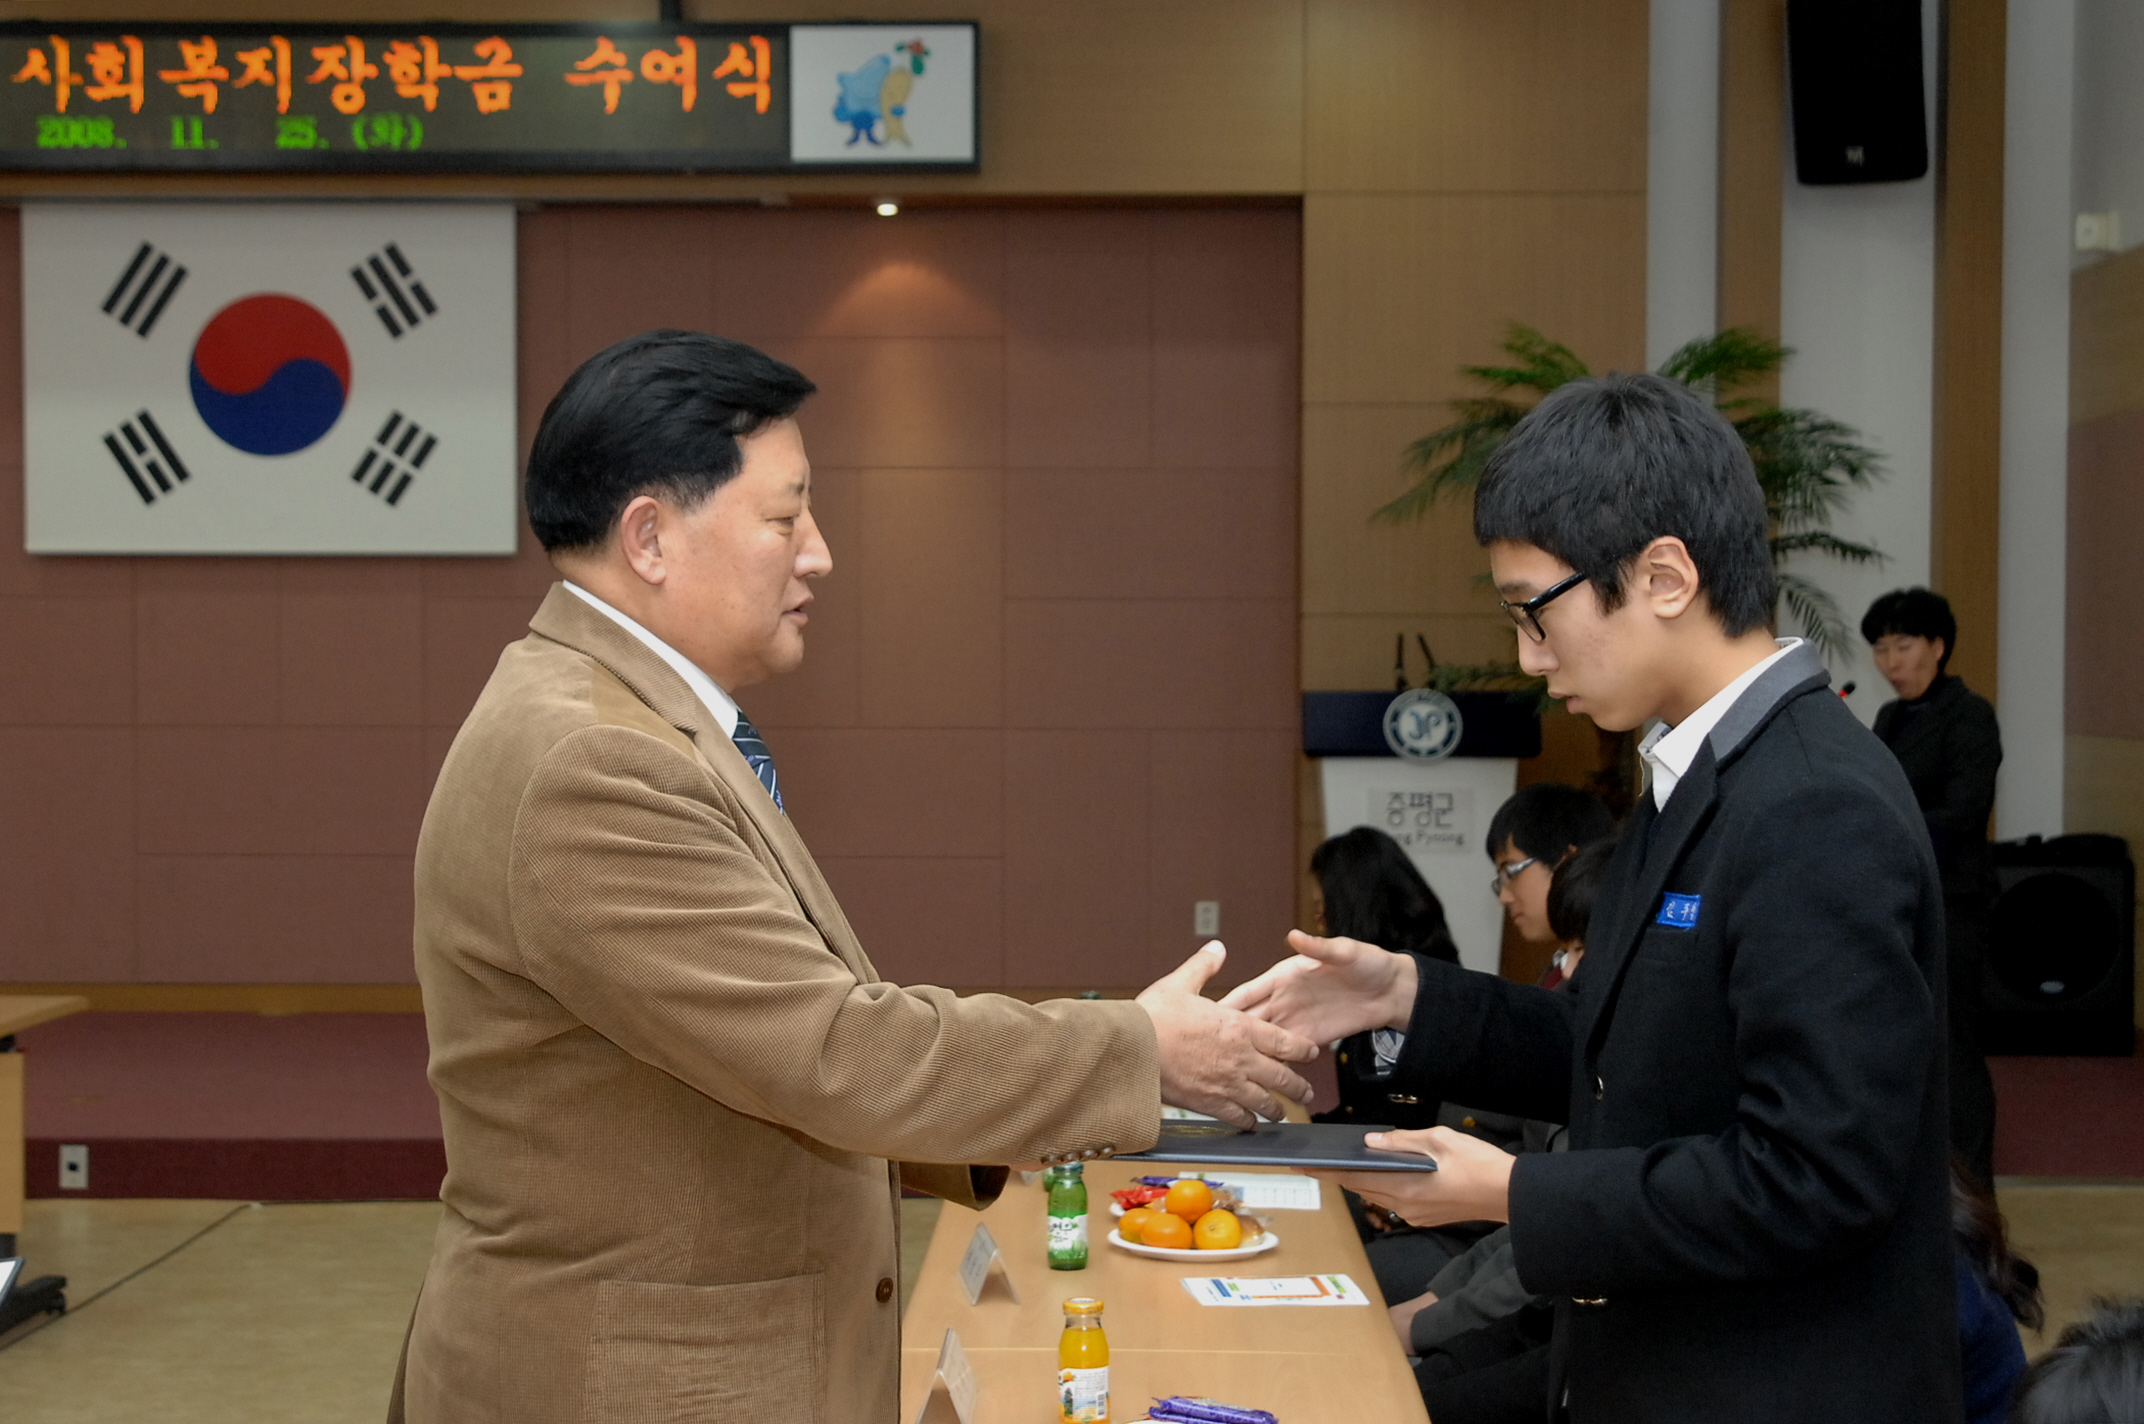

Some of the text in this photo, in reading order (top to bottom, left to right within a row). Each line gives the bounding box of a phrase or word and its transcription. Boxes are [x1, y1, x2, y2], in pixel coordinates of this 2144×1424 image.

[11, 34, 772, 115] 사회복지장학금 수여식
[170, 115, 219, 149] 11.
[275, 115, 329, 149] 25.
[1387, 792, 1454, 827] 증평군
